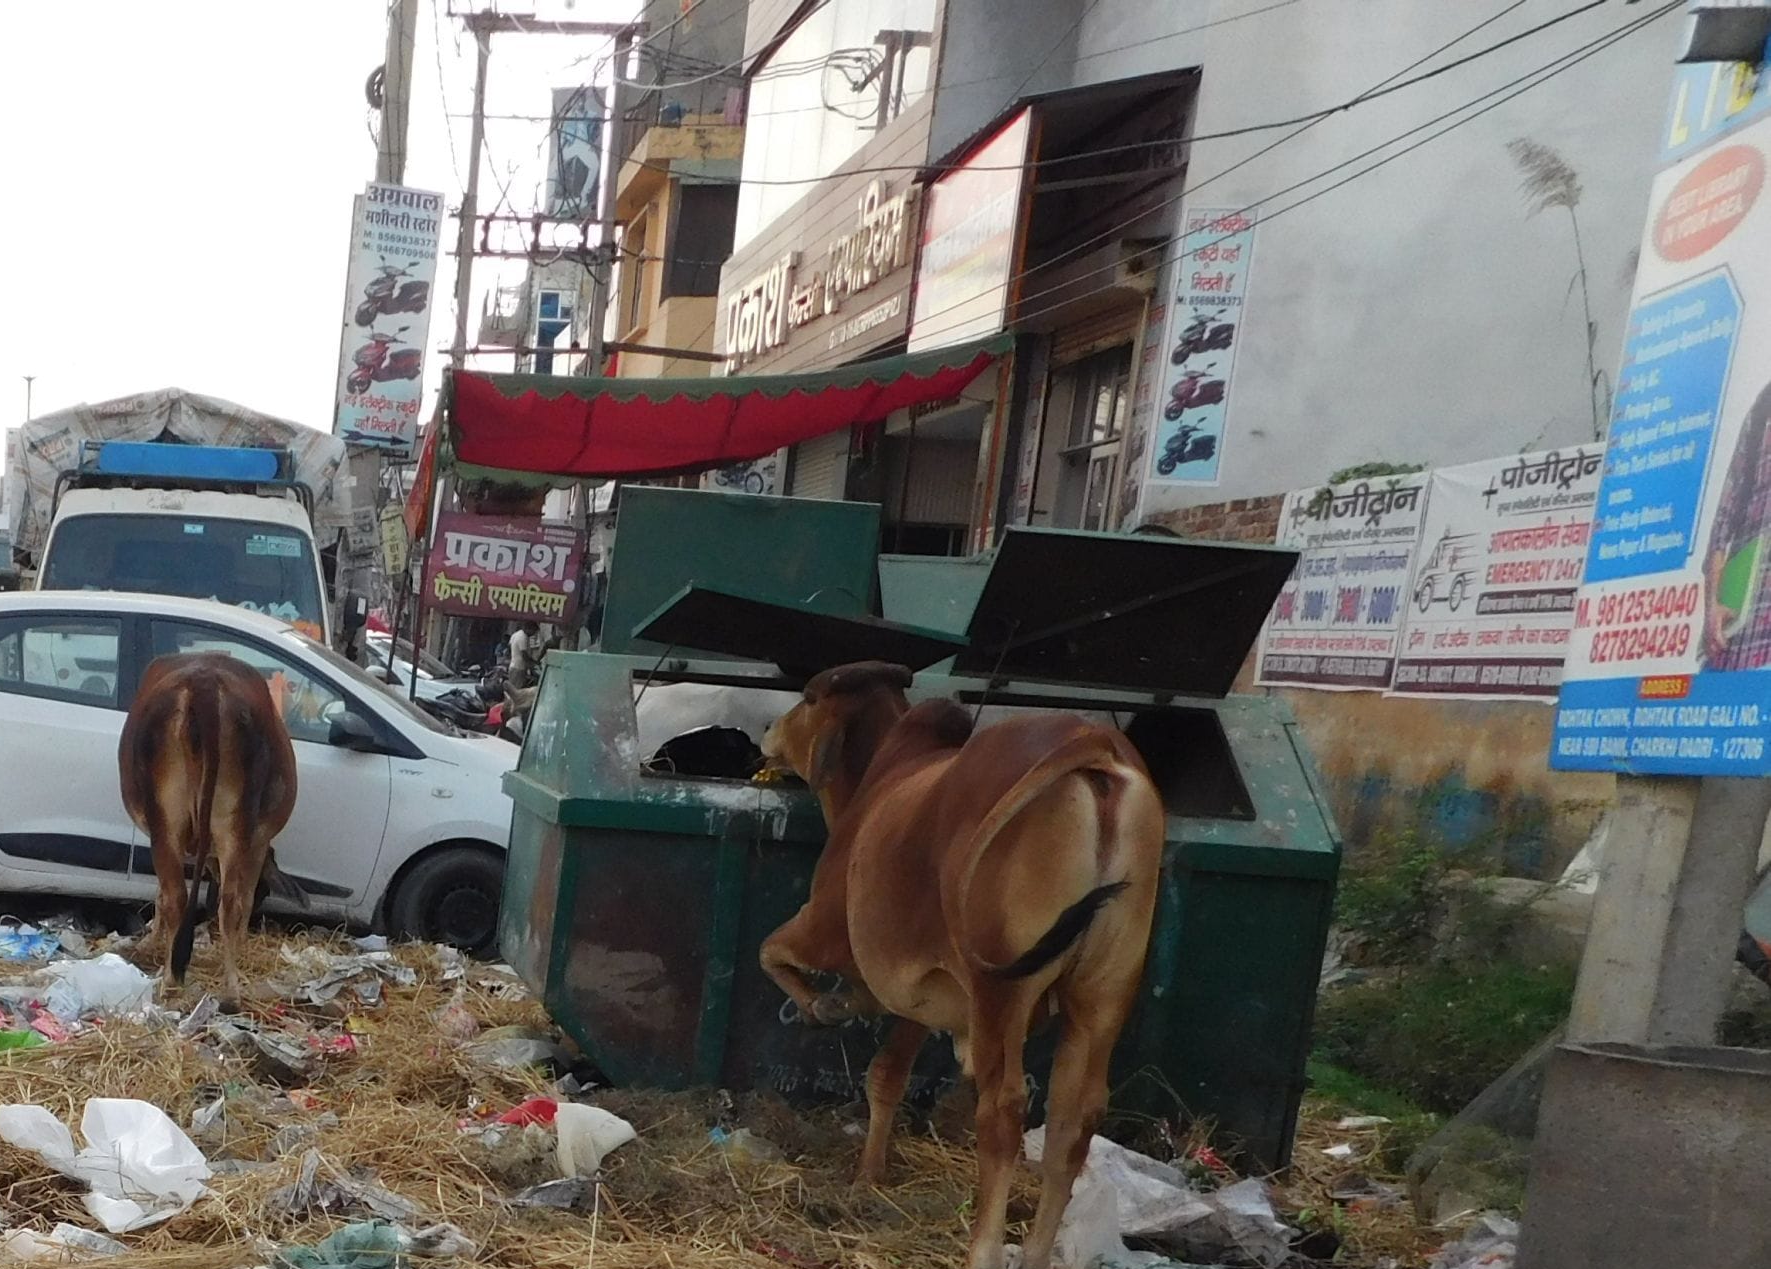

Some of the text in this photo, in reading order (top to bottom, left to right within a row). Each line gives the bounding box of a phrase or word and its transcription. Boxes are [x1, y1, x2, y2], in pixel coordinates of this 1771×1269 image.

[367, 185, 441, 211] अग्रवाल
[365, 208, 410, 230] मशीनरी
[725, 252, 795, 376] प्रकाश
[1485, 558, 1553, 585] EMERGENCY
[434, 571, 567, 618] फैन्सी एम्पोरियम
[1574, 598, 1590, 629] M.
[1595, 582, 1699, 627] 9812534040
[1589, 622, 1691, 664] 8278294249
[1678, 706, 1708, 727] ROAD
